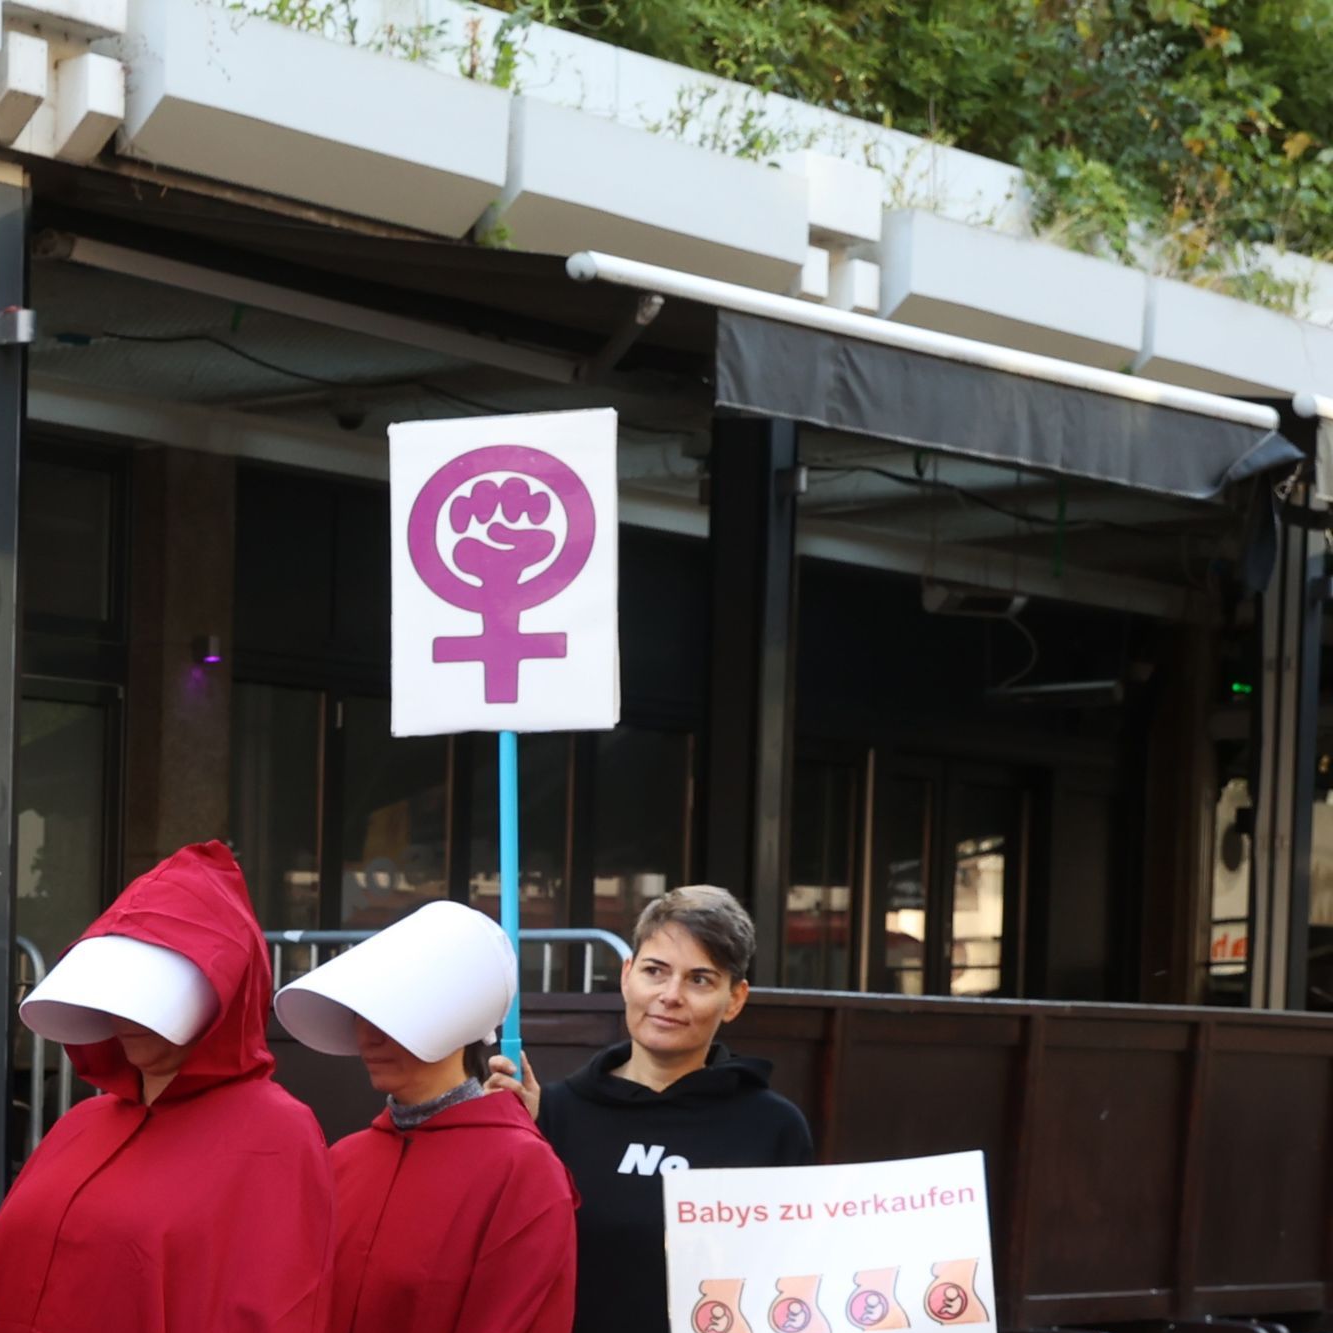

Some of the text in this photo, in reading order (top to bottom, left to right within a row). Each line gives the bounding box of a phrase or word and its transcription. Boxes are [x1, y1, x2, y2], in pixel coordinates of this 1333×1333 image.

[677, 1186, 976, 1228] Babys zu verkaufen
